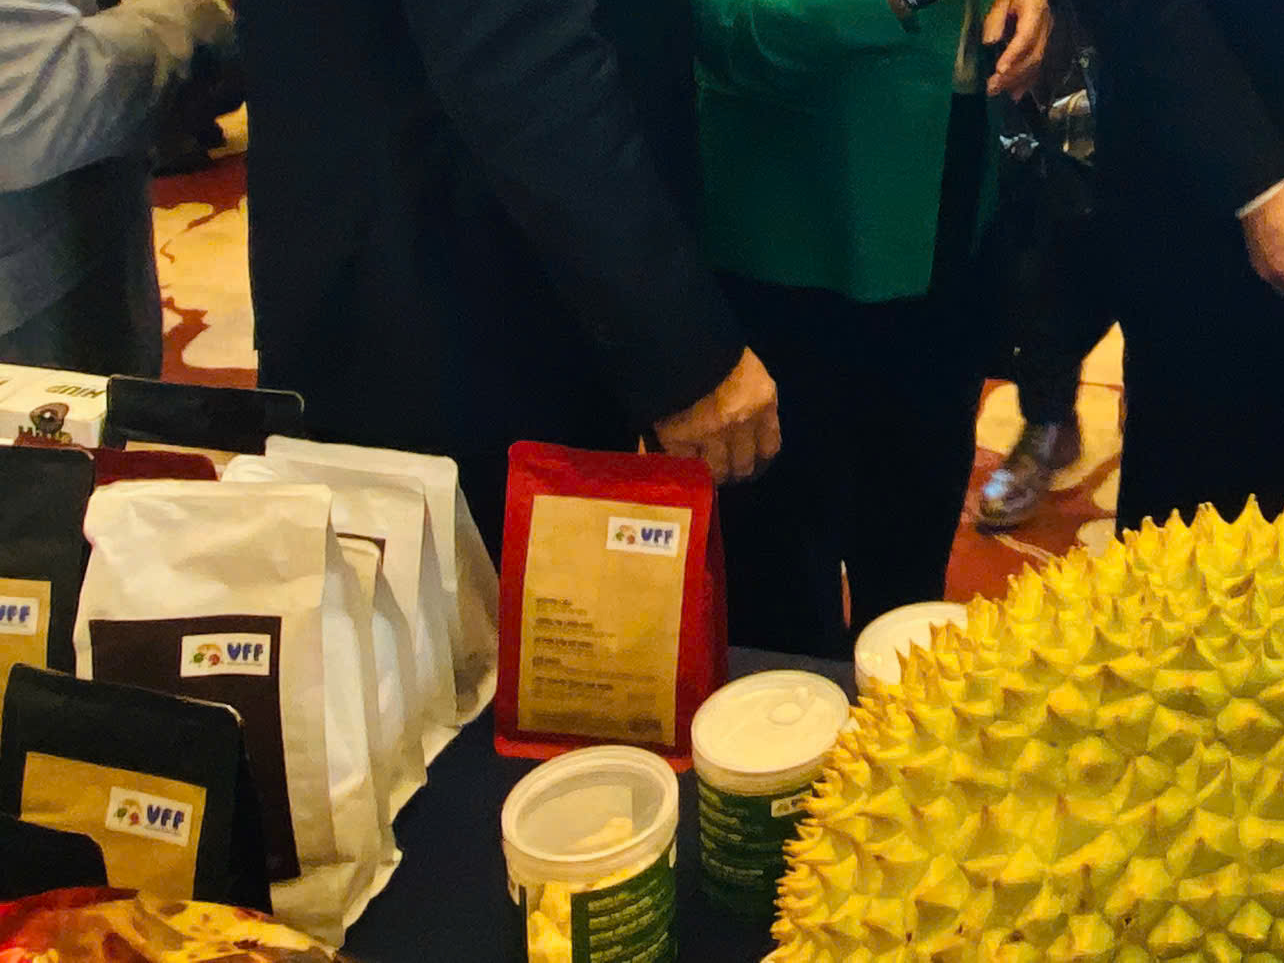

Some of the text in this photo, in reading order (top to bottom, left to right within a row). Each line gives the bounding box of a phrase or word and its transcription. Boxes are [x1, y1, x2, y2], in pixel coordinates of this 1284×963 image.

[641, 527, 673, 545] VFF
[226, 643, 264, 662] VFF
[146, 804, 185, 830] VFF
